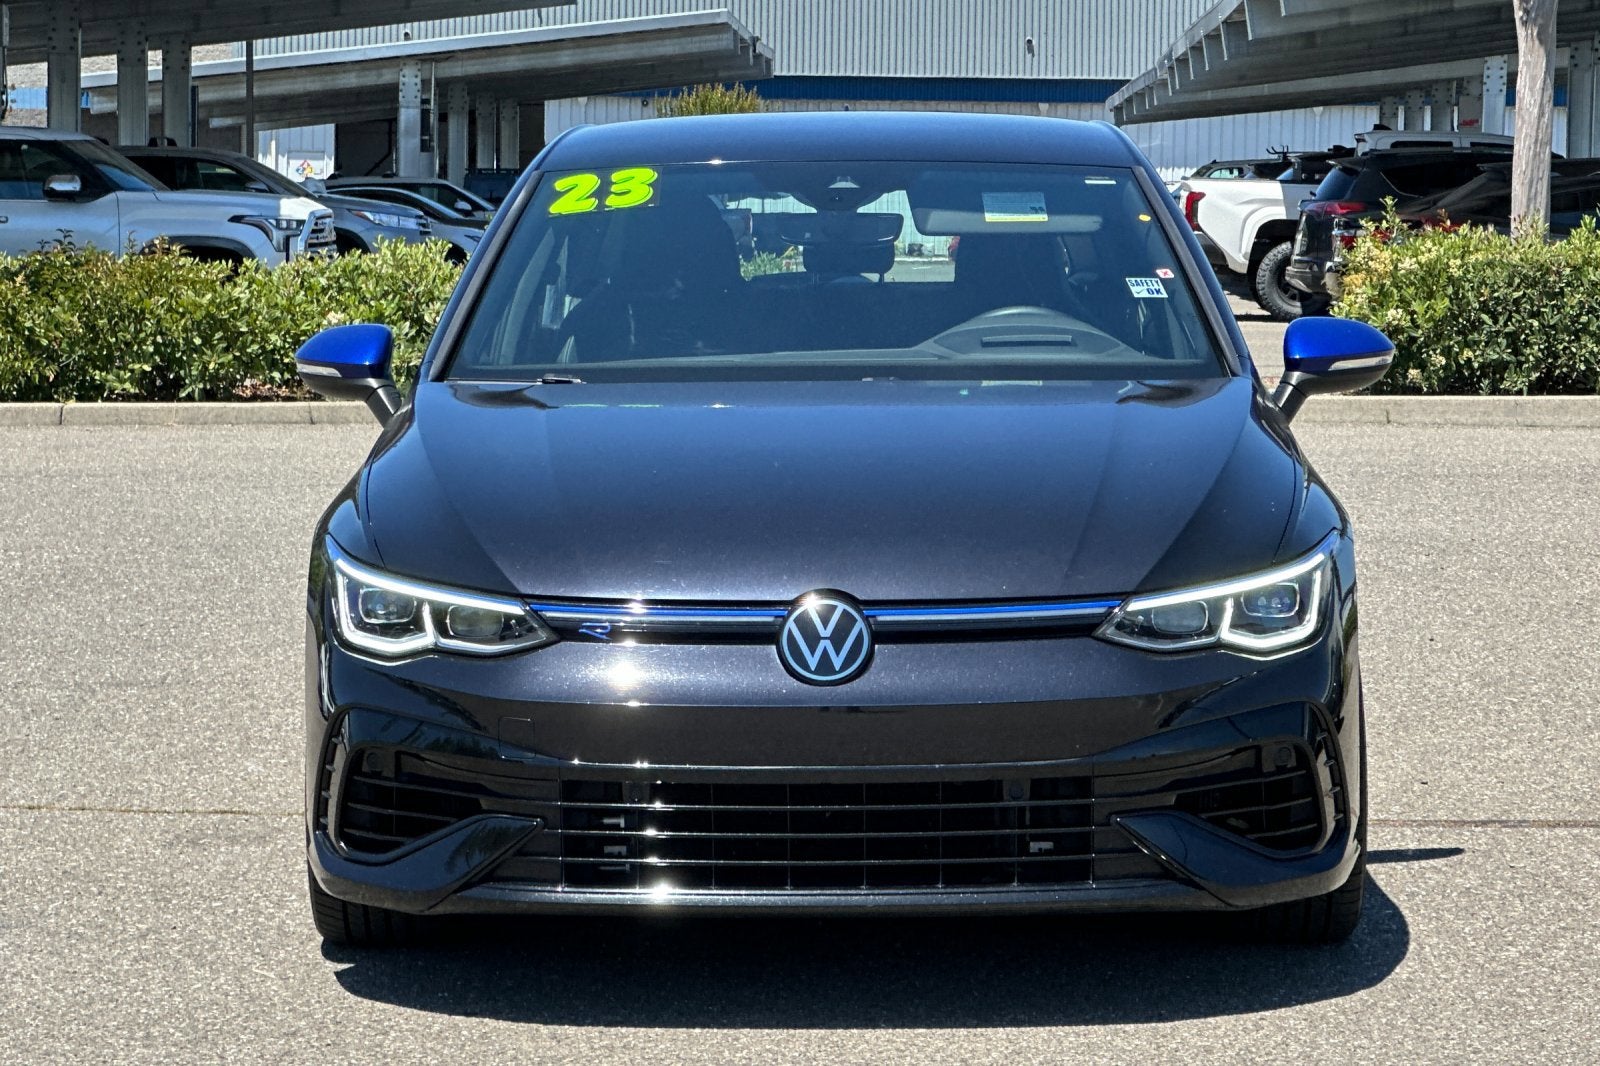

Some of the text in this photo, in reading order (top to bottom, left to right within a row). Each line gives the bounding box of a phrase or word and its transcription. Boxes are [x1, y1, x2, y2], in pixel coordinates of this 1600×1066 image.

[549, 167, 658, 214] 23
[1128, 279, 1161, 287] SAFETY
[1146, 287, 1164, 295] OK
